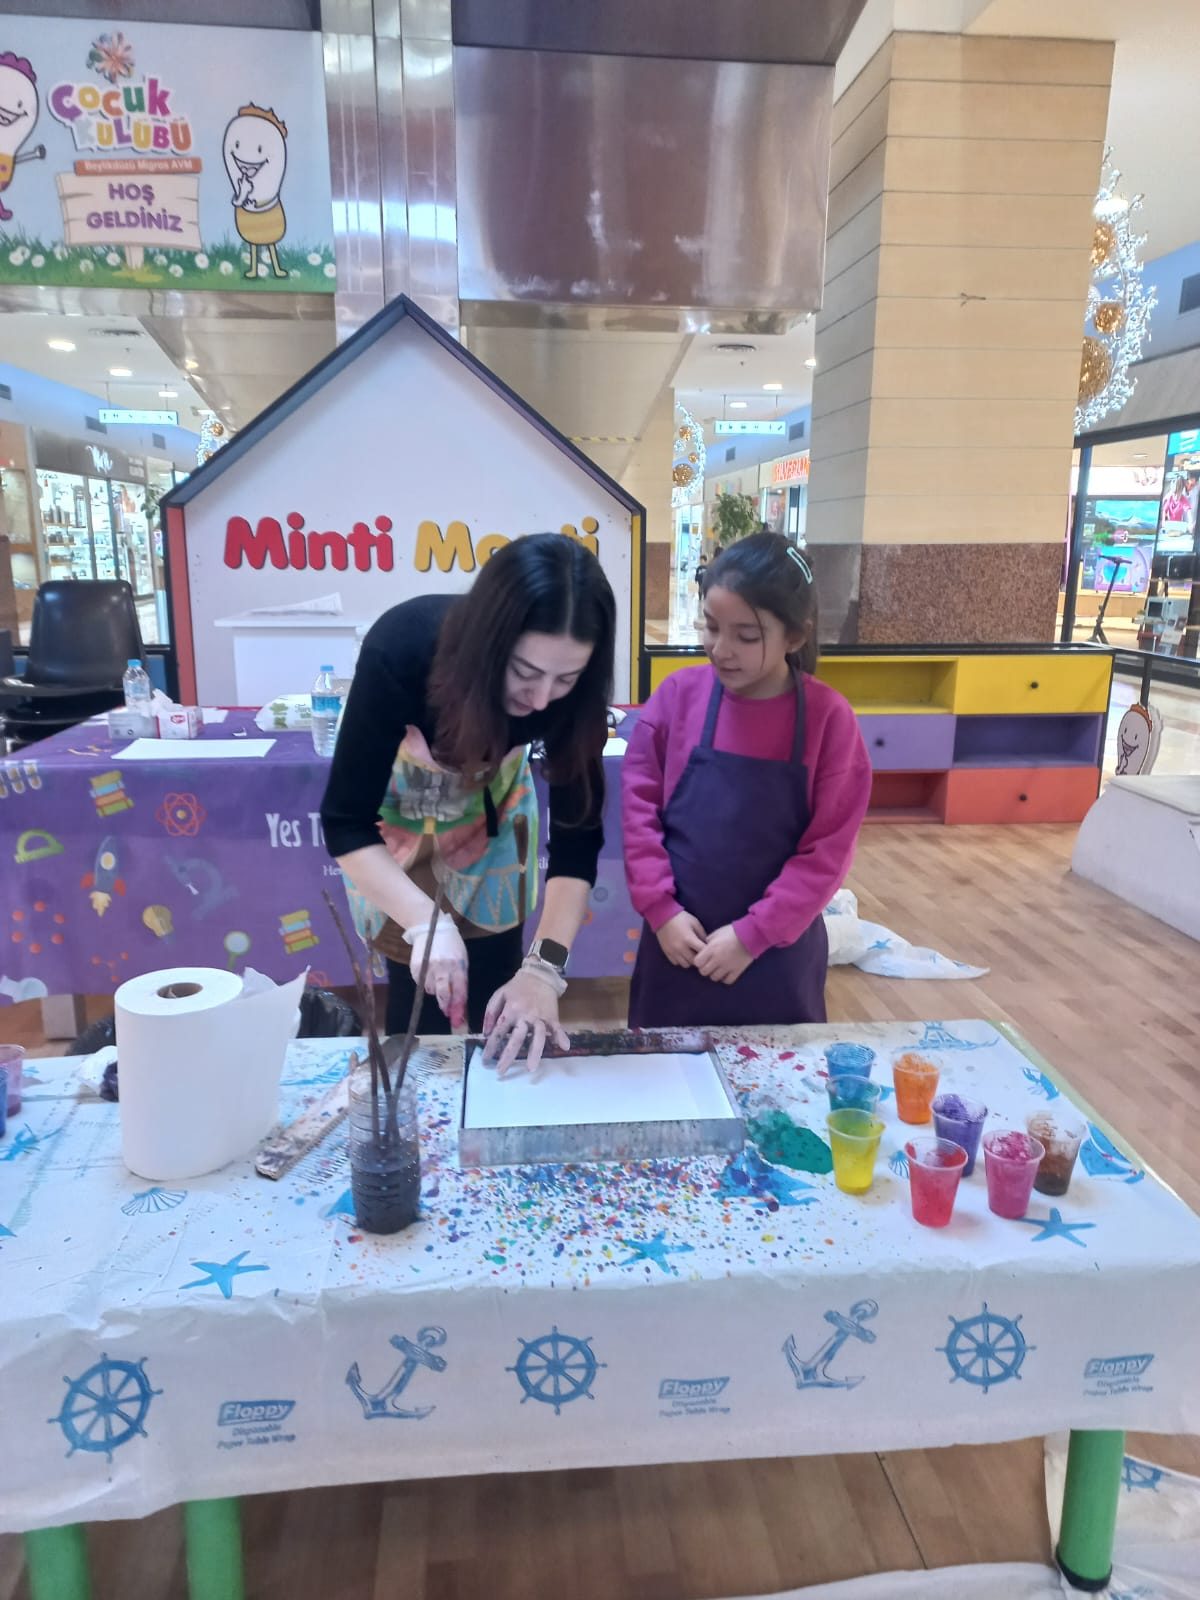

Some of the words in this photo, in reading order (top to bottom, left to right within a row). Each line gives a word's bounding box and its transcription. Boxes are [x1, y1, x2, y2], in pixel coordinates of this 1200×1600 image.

[171, 158, 193, 169] AVM
[108, 183, 155, 206] HOŞ
[86, 206, 183, 232] GELDİNİZ
[223, 511, 395, 573] Minti
[265, 813, 302, 848] Yes
[1087, 1358, 1149, 1376] Floppy
[661, 1380, 725, 1398] Floppy
[221, 1402, 291, 1421] Floppy
